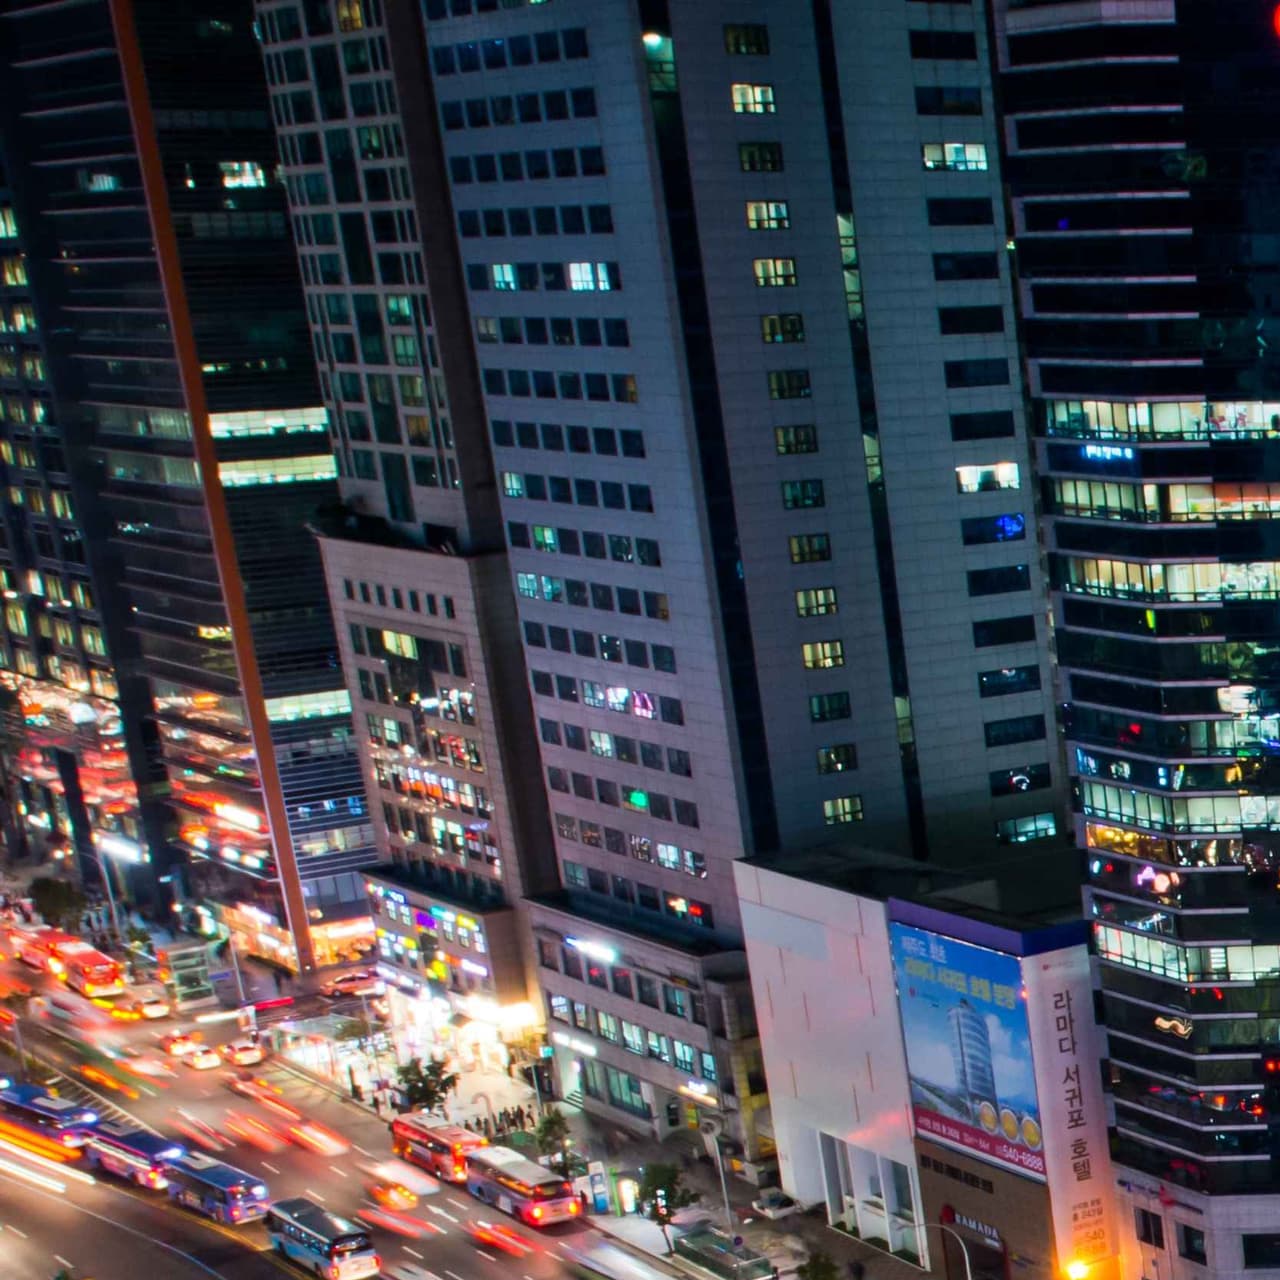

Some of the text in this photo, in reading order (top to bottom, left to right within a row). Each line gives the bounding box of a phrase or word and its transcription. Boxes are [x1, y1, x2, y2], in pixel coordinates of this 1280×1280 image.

[1053, 989, 1077, 1056] 라마다
[1061, 1063, 1088, 1131] 서귀포
[1070, 1138, 1093, 1183] 호텔
